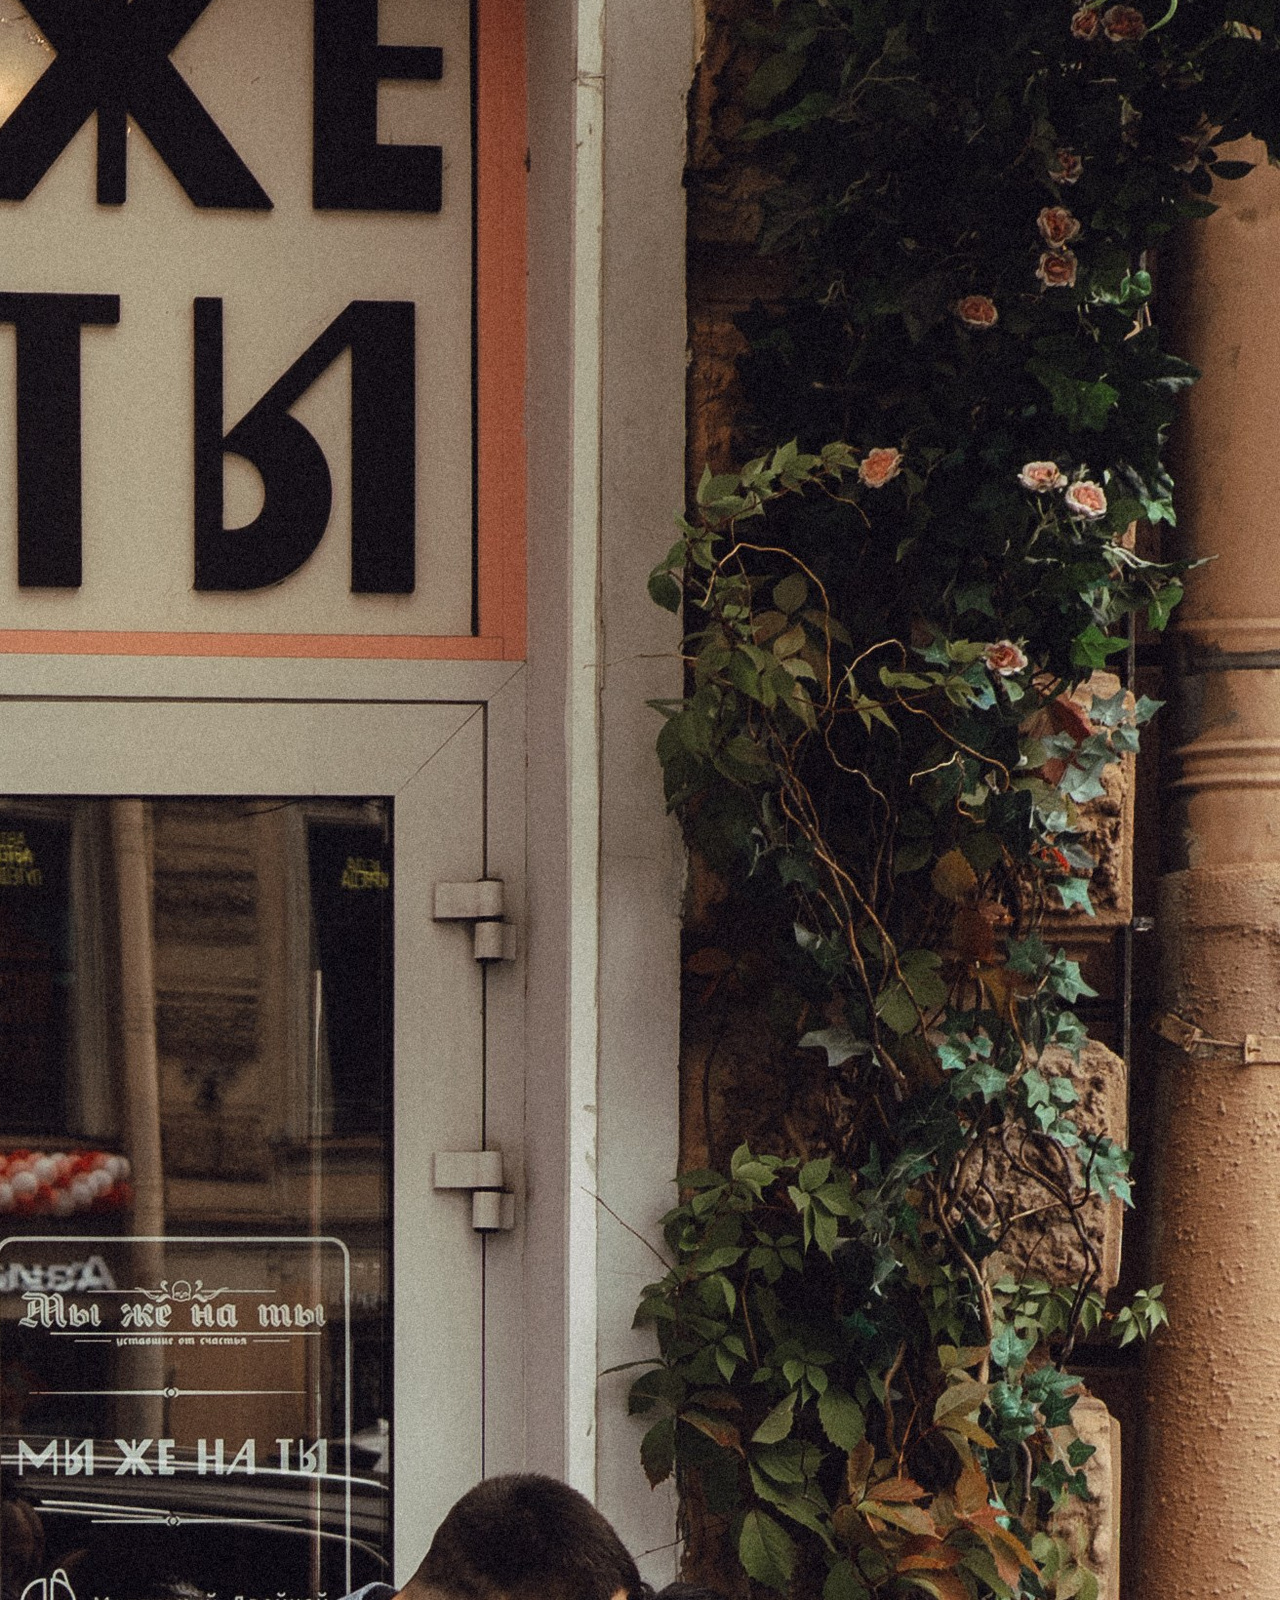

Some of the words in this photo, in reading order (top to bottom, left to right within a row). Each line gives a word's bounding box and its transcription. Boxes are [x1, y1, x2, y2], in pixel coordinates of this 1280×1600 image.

[18, 1291, 101, 1328] Мы
[120, 1303, 172, 1328] же
[190, 1303, 238, 1328] на
[257, 1303, 326, 1328] ты
[178, 1338, 195, 1346] от
[199, 1337, 247, 1346] счастья
[114, 1438, 176, 1476] ЖЕ
[197, 1438, 256, 1475] НА
